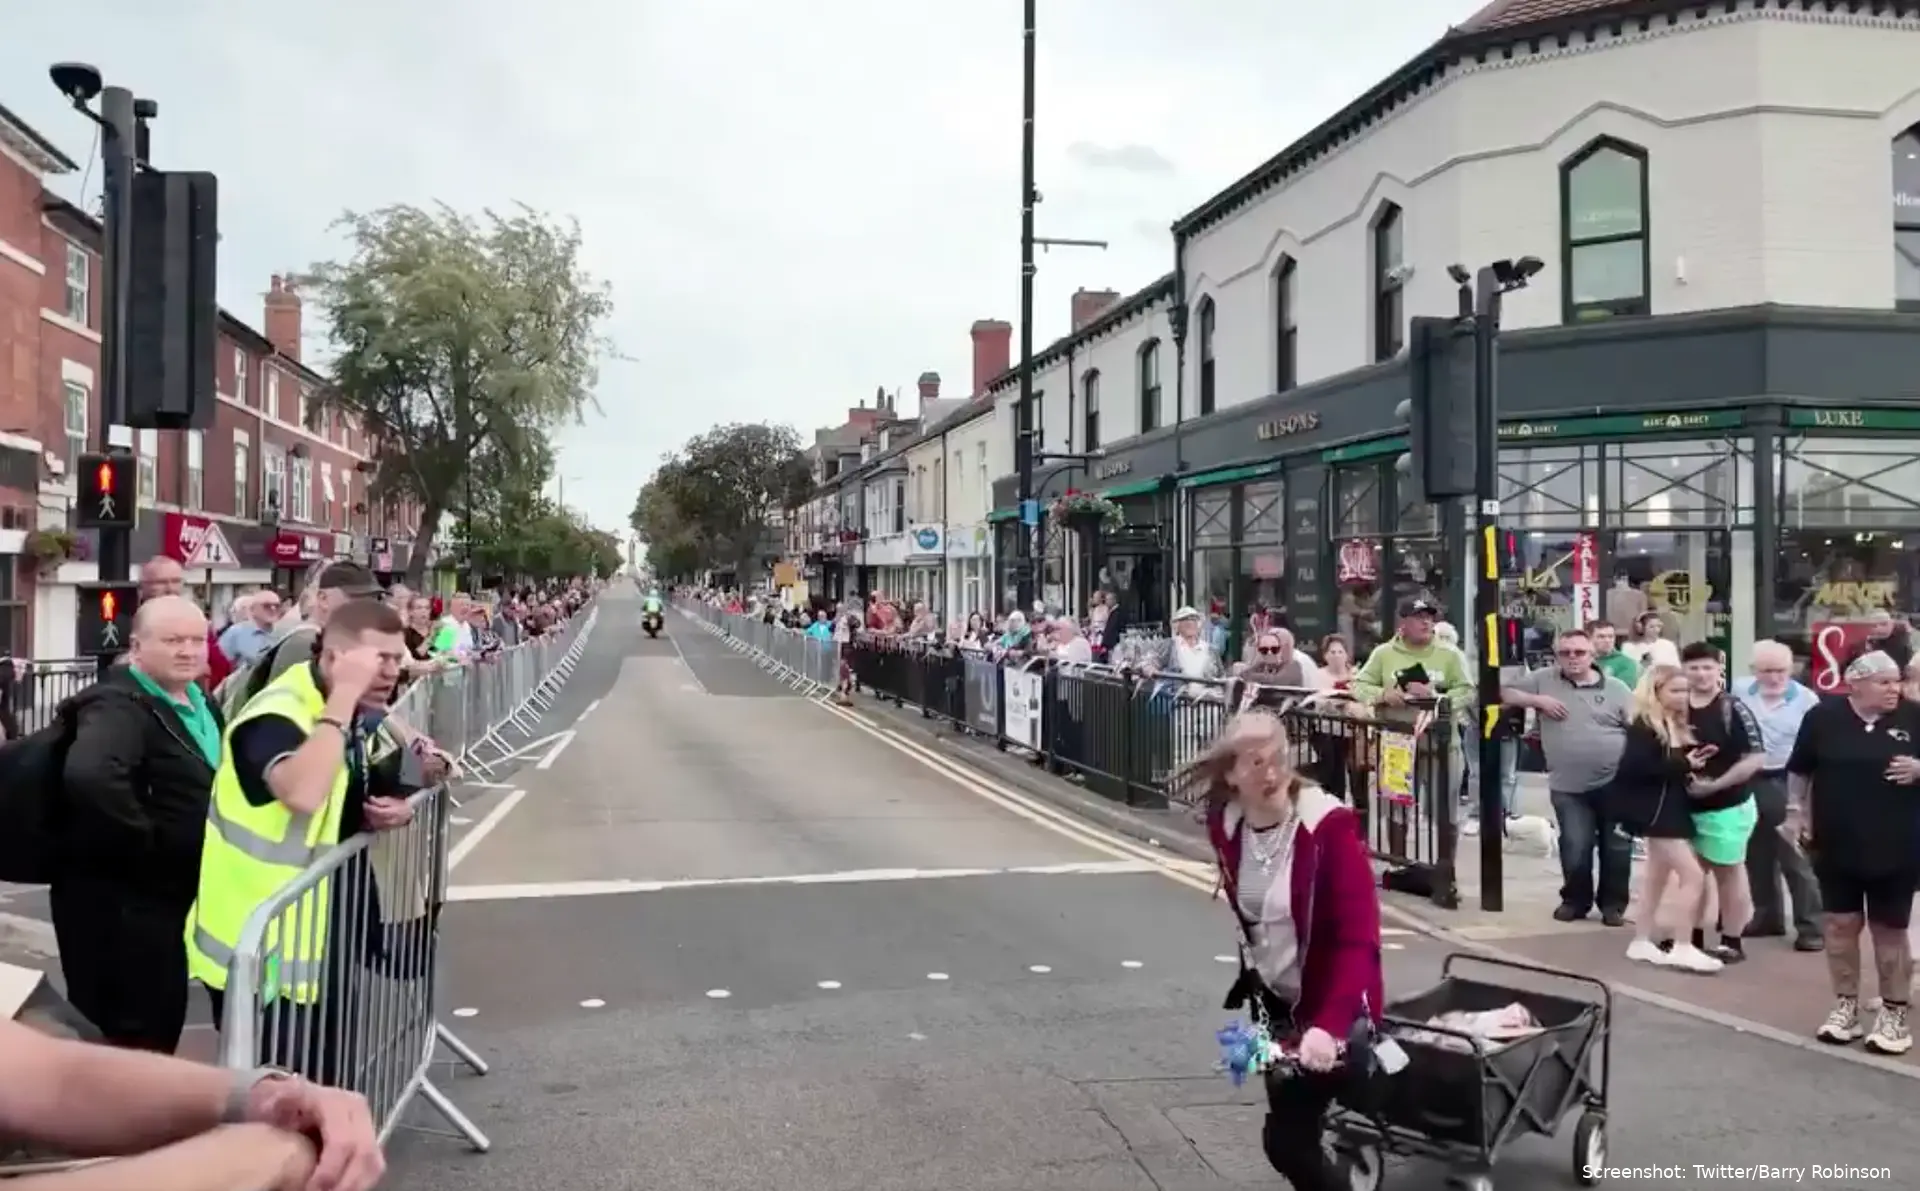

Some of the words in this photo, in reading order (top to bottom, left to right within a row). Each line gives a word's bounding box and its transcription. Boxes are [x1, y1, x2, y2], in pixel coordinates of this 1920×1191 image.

[1814, 410, 1864, 426] LUKE
[1580, 535, 1594, 583] SALE
[1581, 586, 1593, 622] SAL
